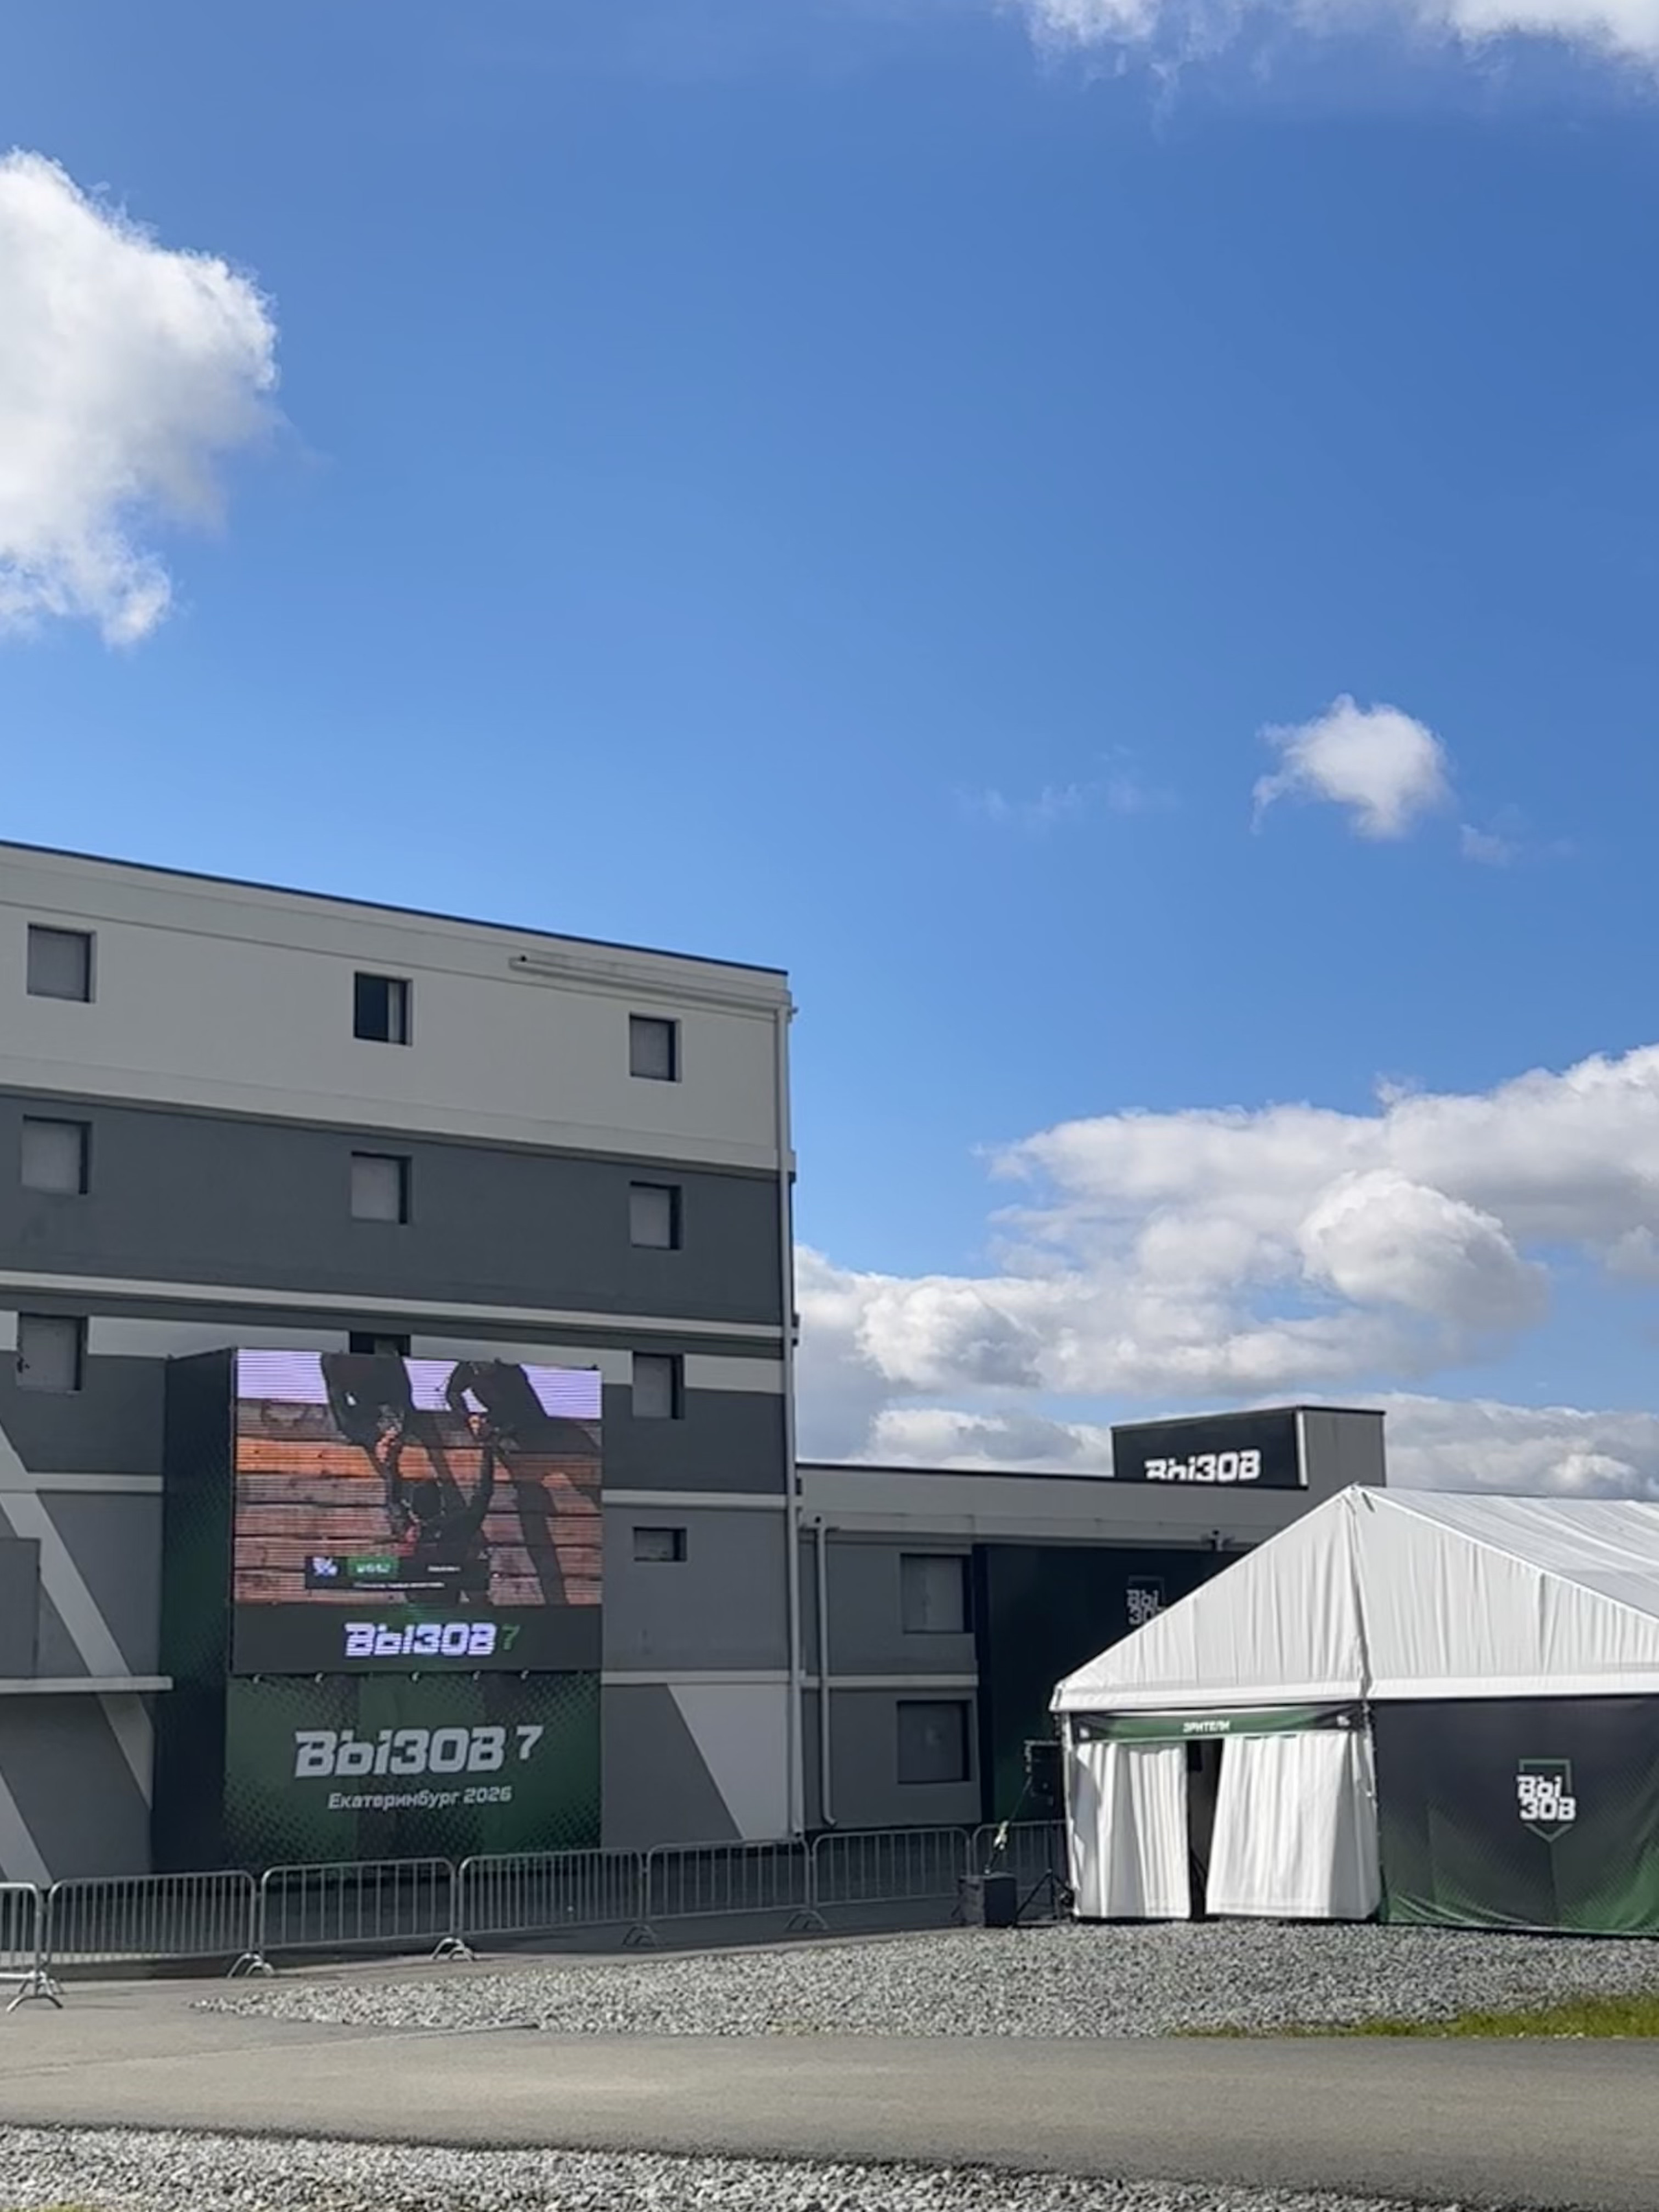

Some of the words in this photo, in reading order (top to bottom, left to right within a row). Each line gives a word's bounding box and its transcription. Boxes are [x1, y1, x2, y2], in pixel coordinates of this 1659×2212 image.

[1144, 1449, 1261, 1483] ВЫЗОВ
[1128, 1607, 1163, 1625] ЗО
[345, 1623, 497, 1657] ВЫЗОВ
[502, 1625, 520, 1650] 7
[294, 1727, 506, 1777] ВЫЗОВ
[516, 1726, 544, 1760] 7
[328, 1789, 461, 1811] Екатеринбург
[463, 1786, 513, 1804] 2026
[1516, 1775, 1562, 1799] ВЫ
[1520, 1797, 1576, 1821] ЗОВ
